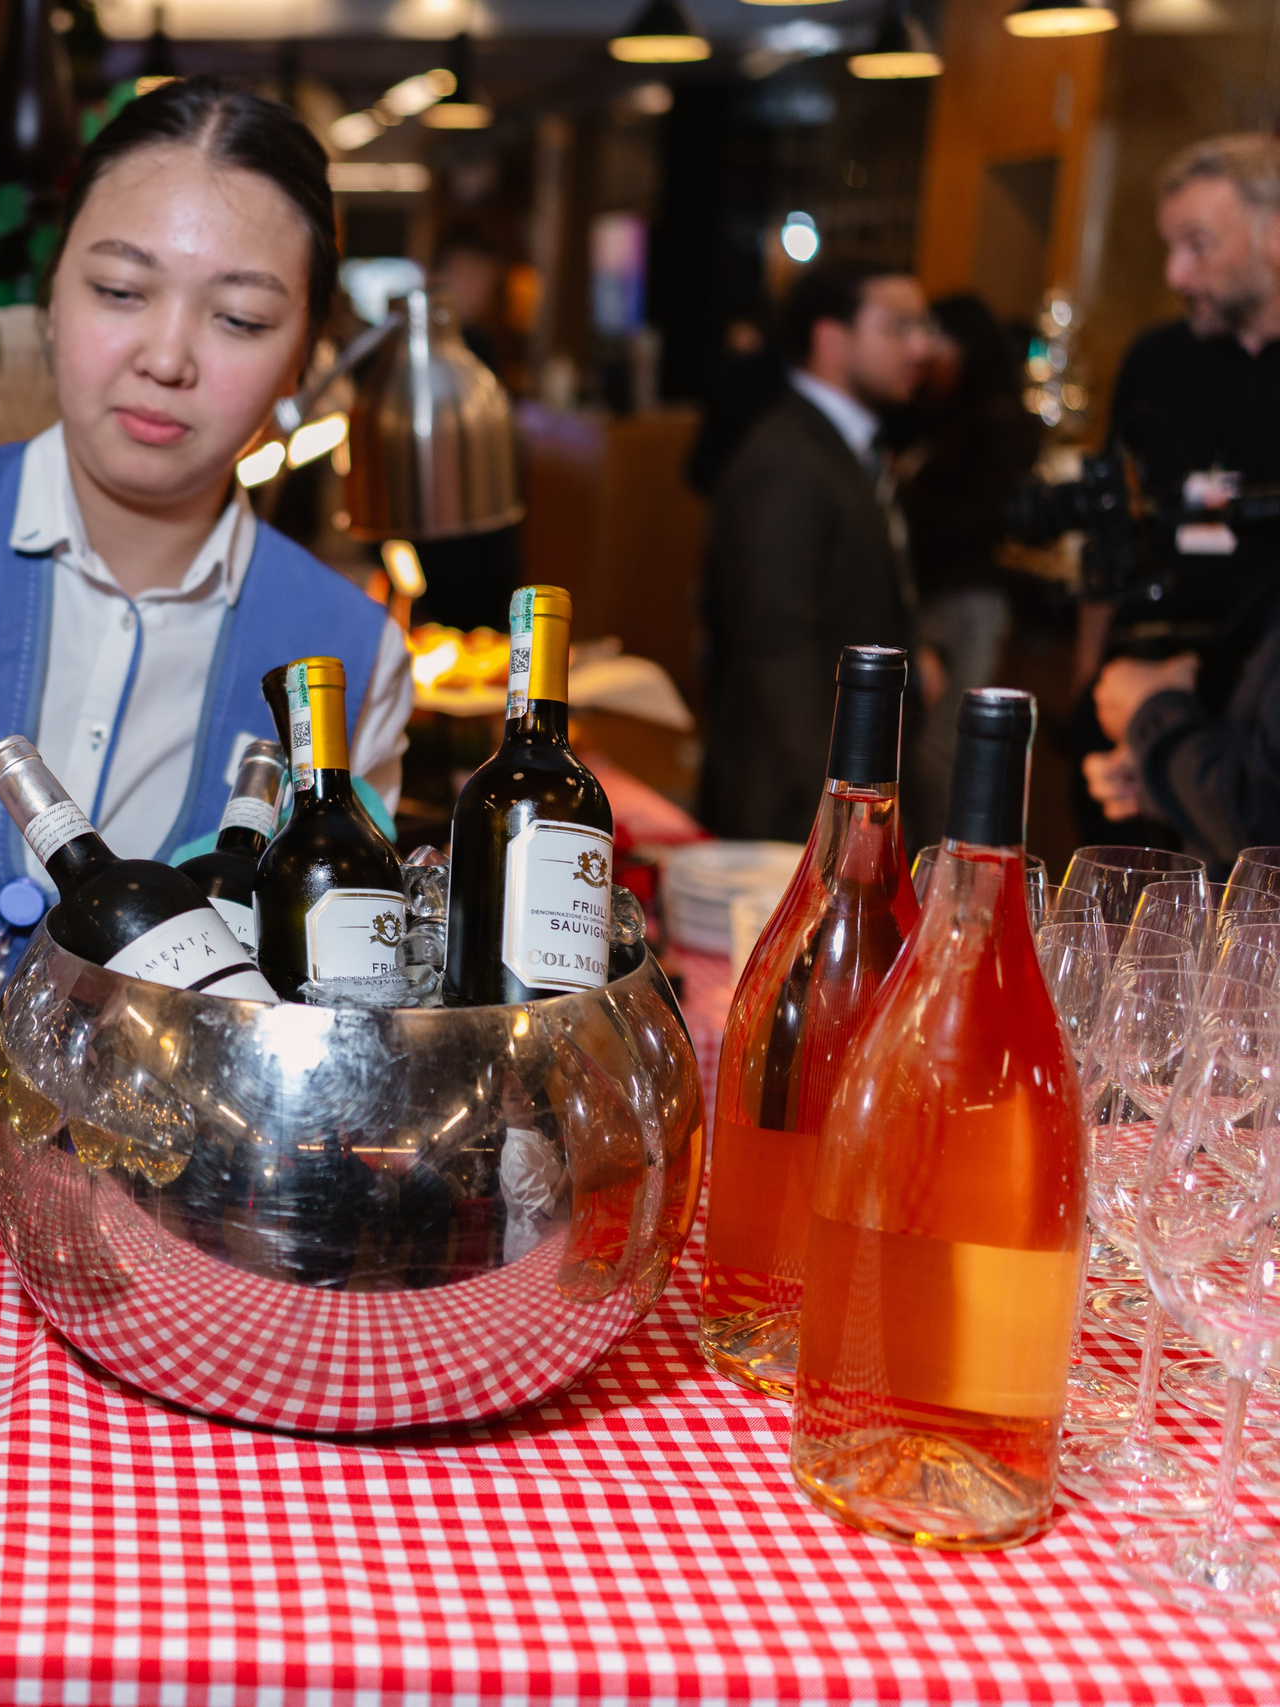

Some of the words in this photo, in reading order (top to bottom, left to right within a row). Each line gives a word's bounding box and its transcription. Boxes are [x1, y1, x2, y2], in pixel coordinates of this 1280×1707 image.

[530, 909, 582, 920] DENOMINAZIONE
[572, 900, 608, 919] FRIULI
[528, 949, 570, 968] COL
